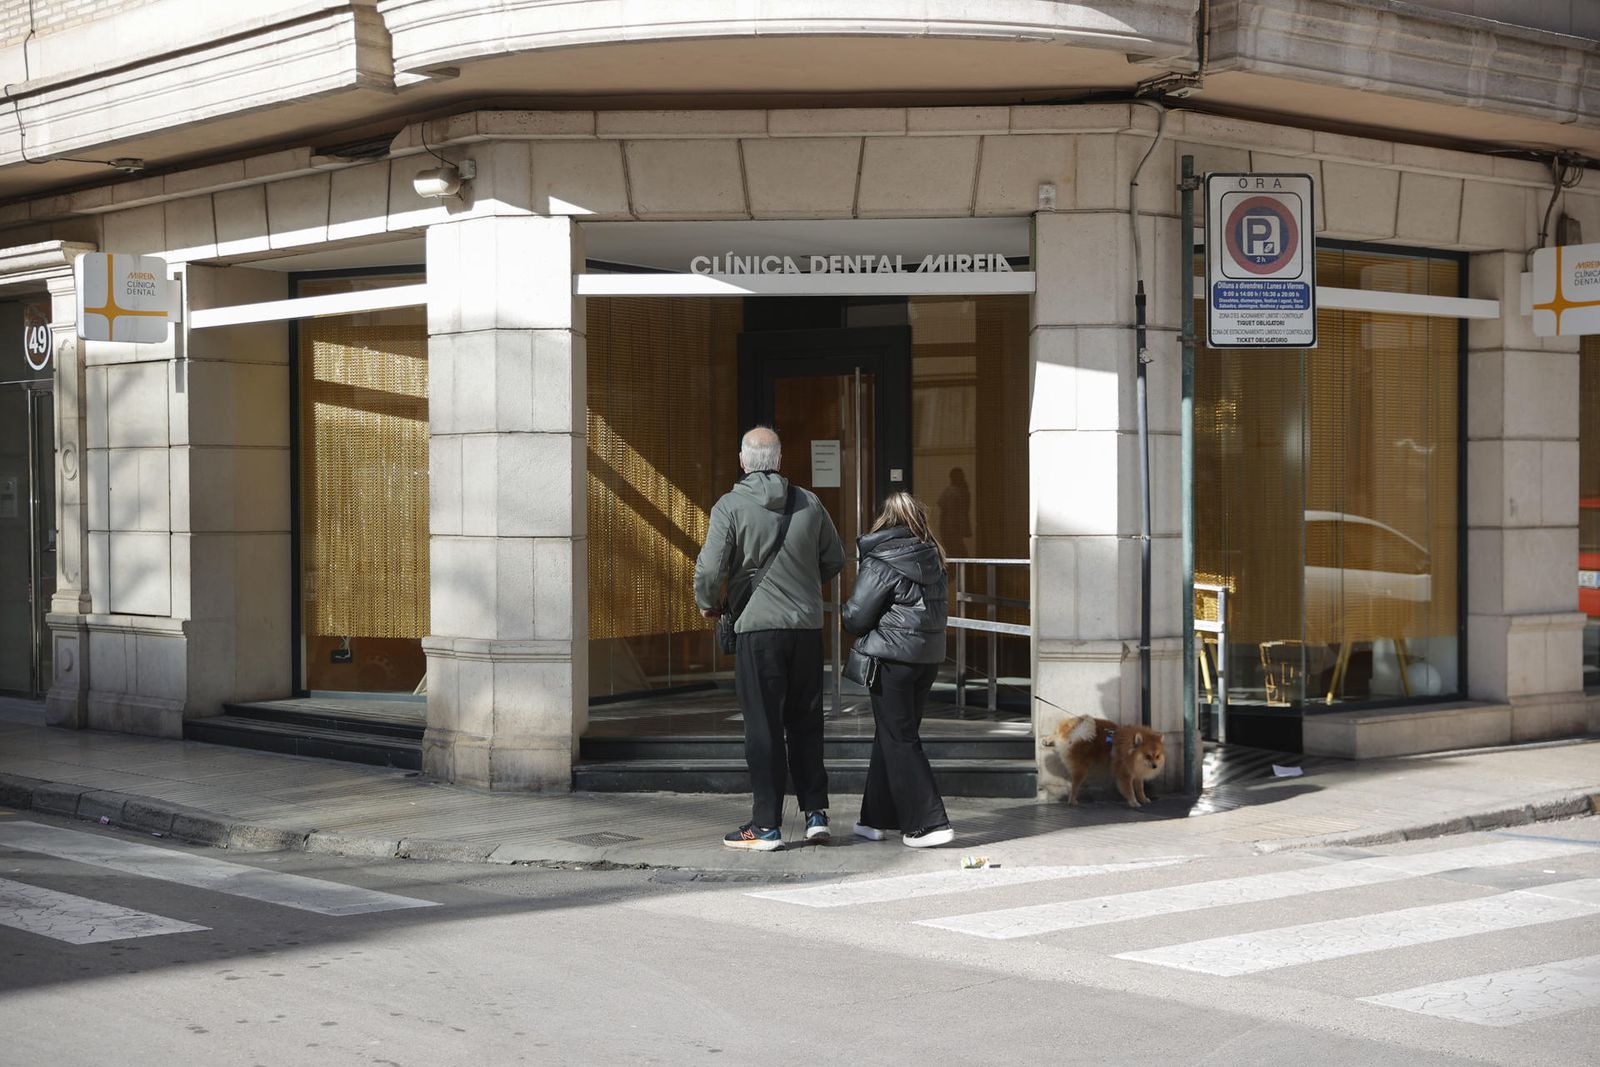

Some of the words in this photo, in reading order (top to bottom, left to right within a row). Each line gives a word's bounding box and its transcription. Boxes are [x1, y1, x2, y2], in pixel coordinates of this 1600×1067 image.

[1246, 218, 1272, 254] P
[690, 251, 801, 274] CLÍNICA
[810, 255, 908, 274] DENTAL
[916, 253, 1014, 273] MIREIA
[127, 271, 156, 281] MIREIA
[126, 280, 156, 289] CLÍNICA
[1574, 277, 1600, 286] DENTA
[126, 288, 156, 297] DENTAL
[29, 325, 47, 354] 49
